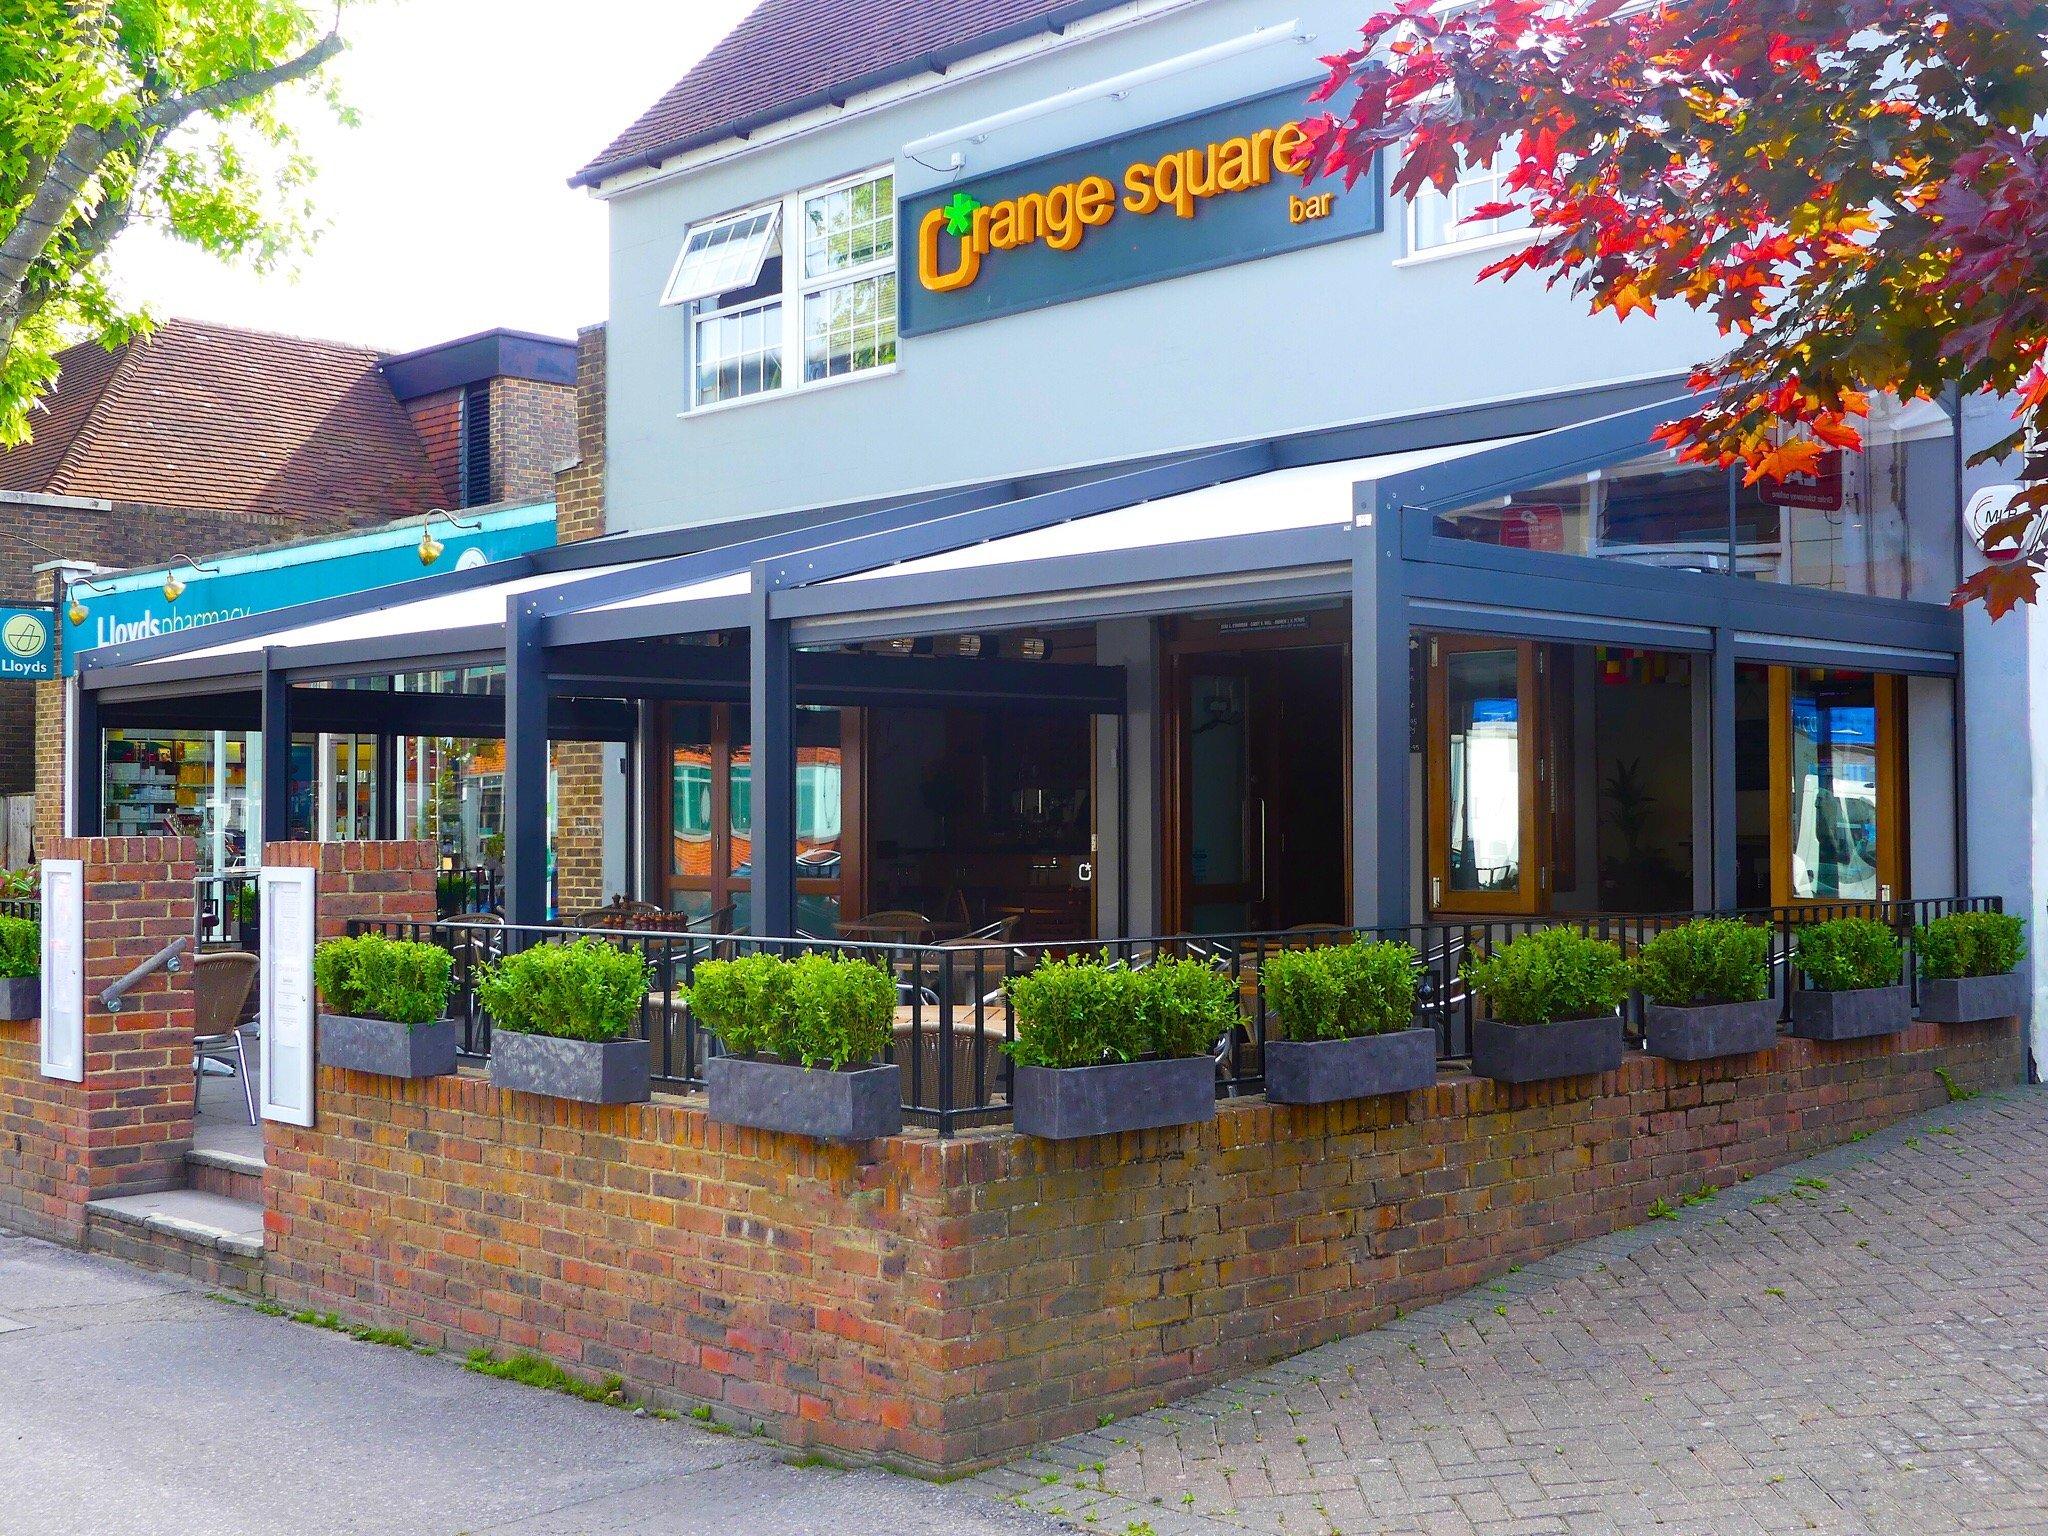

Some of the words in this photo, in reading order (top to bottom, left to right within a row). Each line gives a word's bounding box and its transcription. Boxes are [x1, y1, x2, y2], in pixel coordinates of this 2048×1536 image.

[918, 176, 1115, 292] Orange
[1124, 121, 1311, 218] square
[1289, 190, 1335, 223] bar
[1, 659, 48, 676] Lloyds
